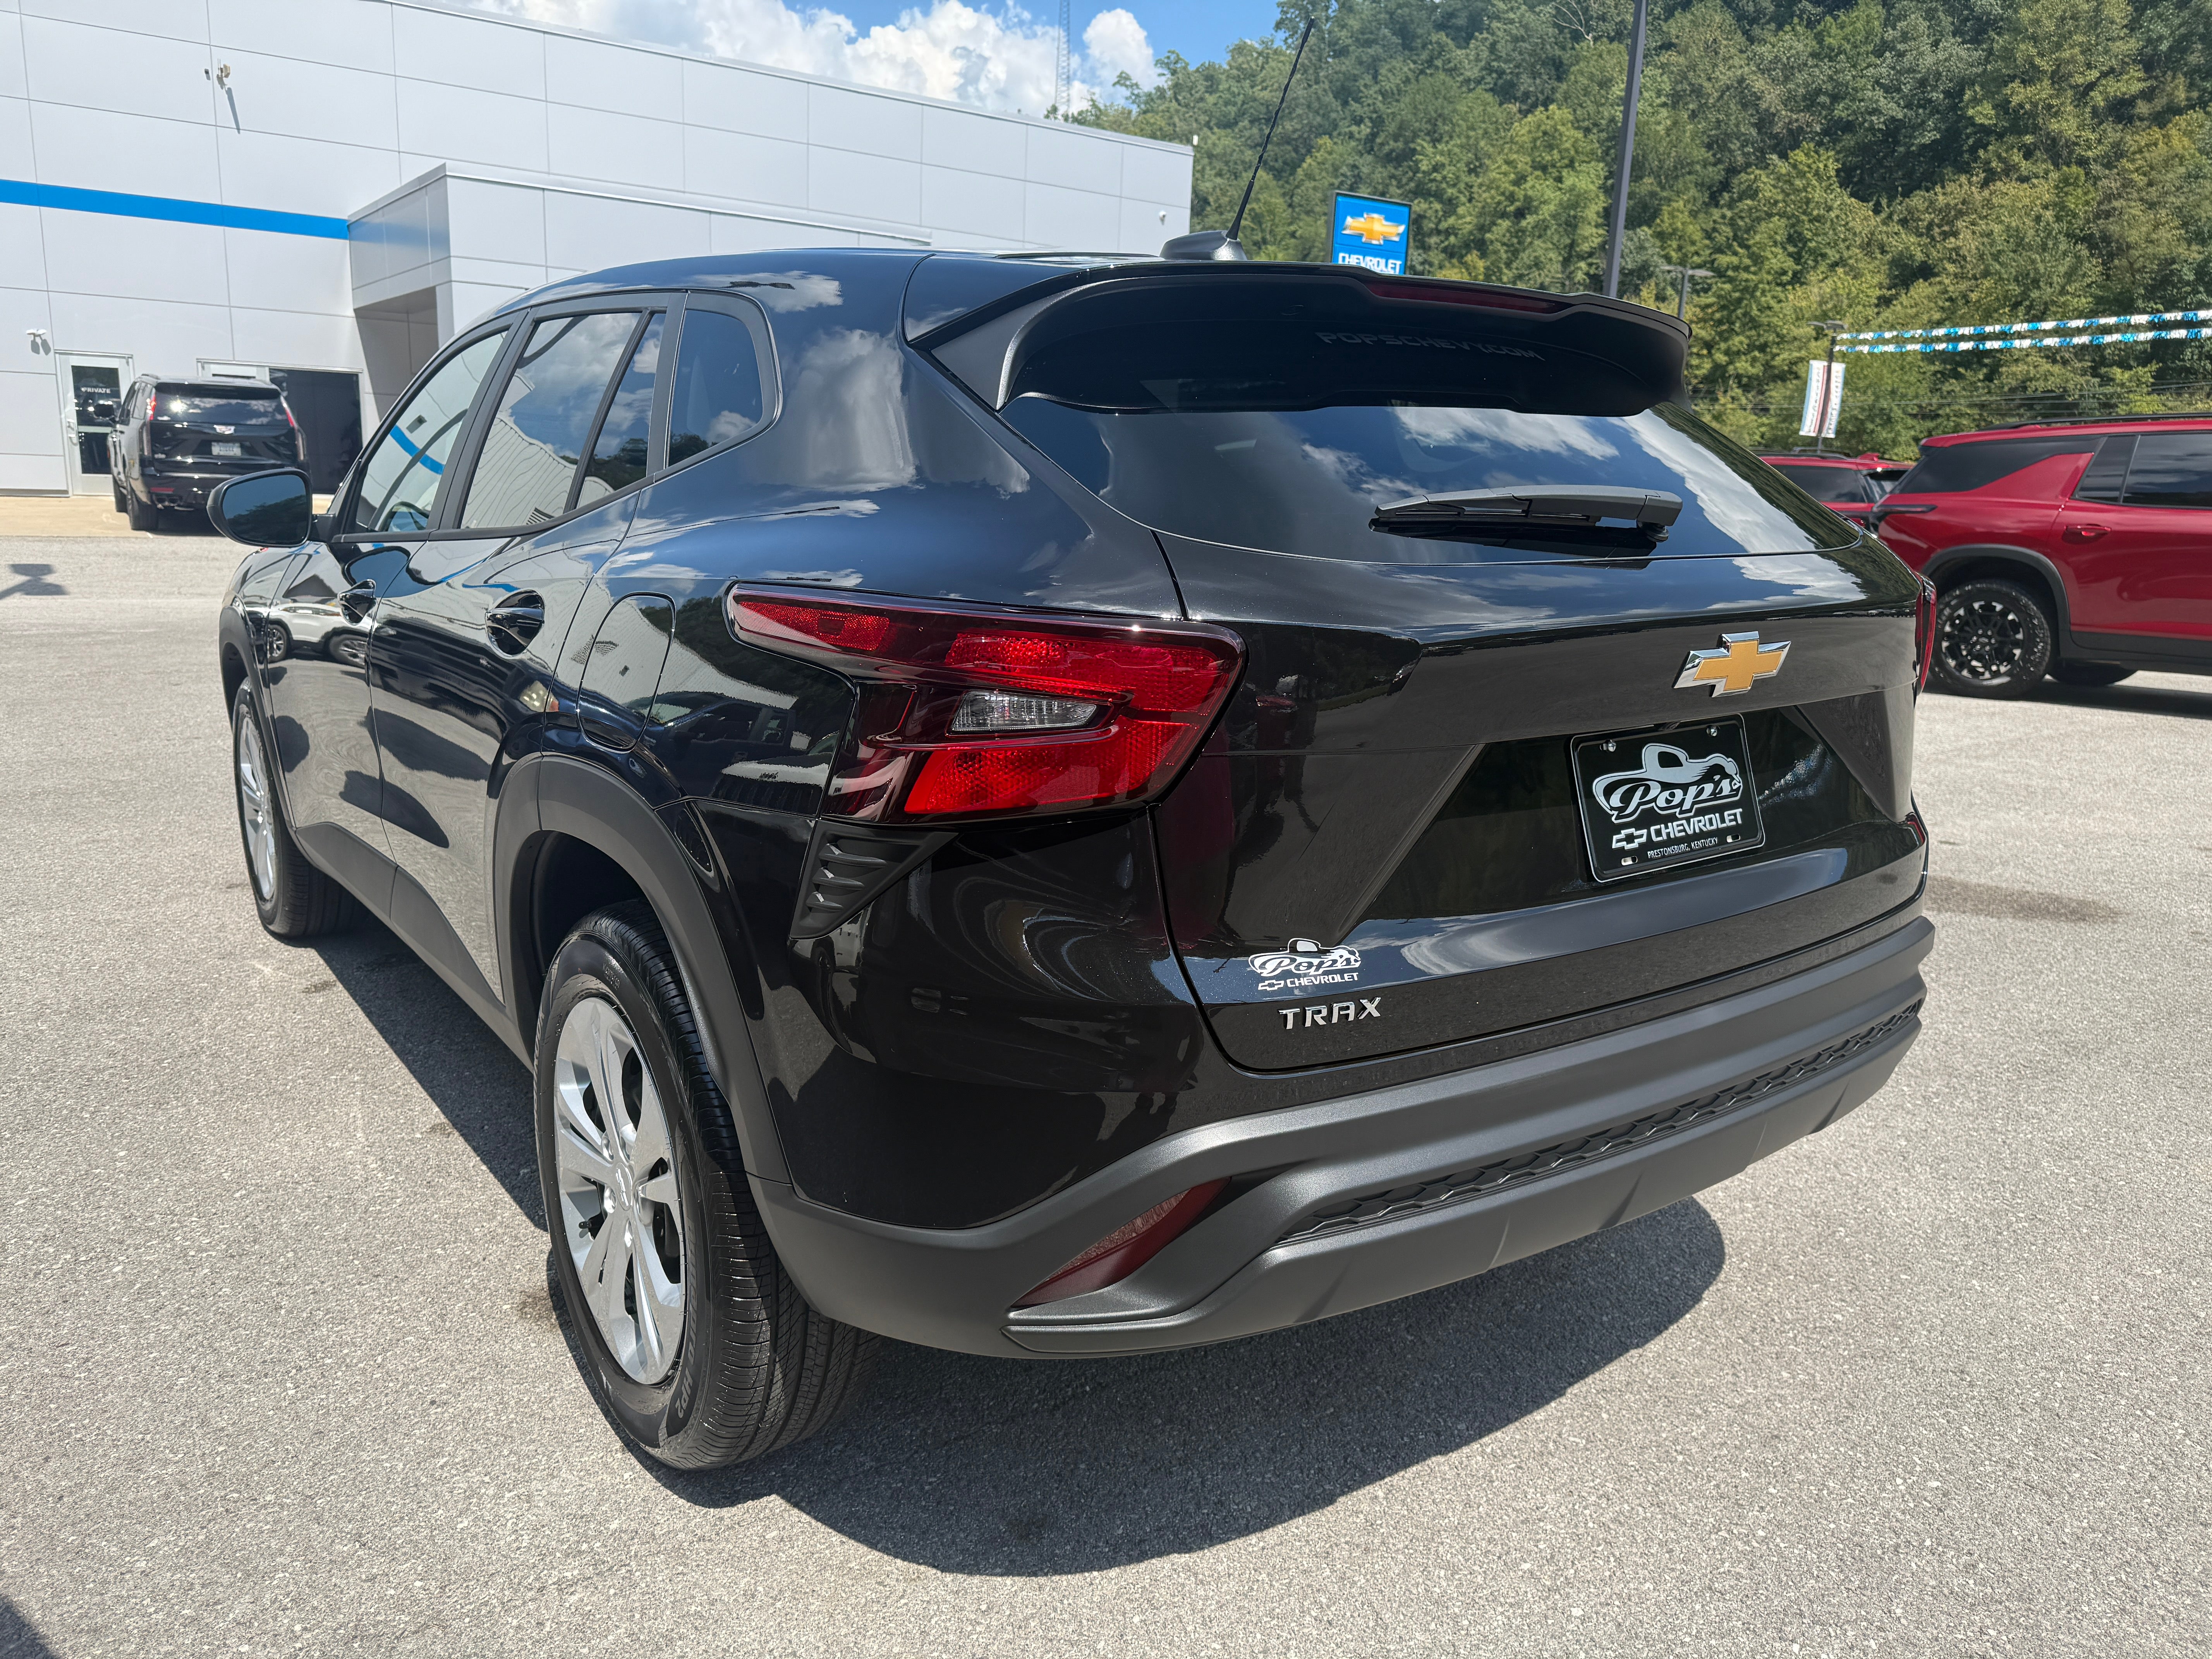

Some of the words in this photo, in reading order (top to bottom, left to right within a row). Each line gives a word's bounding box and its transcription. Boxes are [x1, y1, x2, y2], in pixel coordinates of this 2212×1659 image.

[1338, 252, 1402, 274] CHEVROLET
[1315, 332, 1546, 361] POPSCHEVY.COM
[1609, 775, 1736, 816] Pop's
[1650, 808, 1743, 842] CHEVROLET
[1647, 843, 1690, 859] PRESTONSBURG,
[1691, 837, 1718, 849] KENTUCKY
[1286, 972, 1358, 988] CHEVROLET
[1278, 997, 1382, 1030] TRAX
